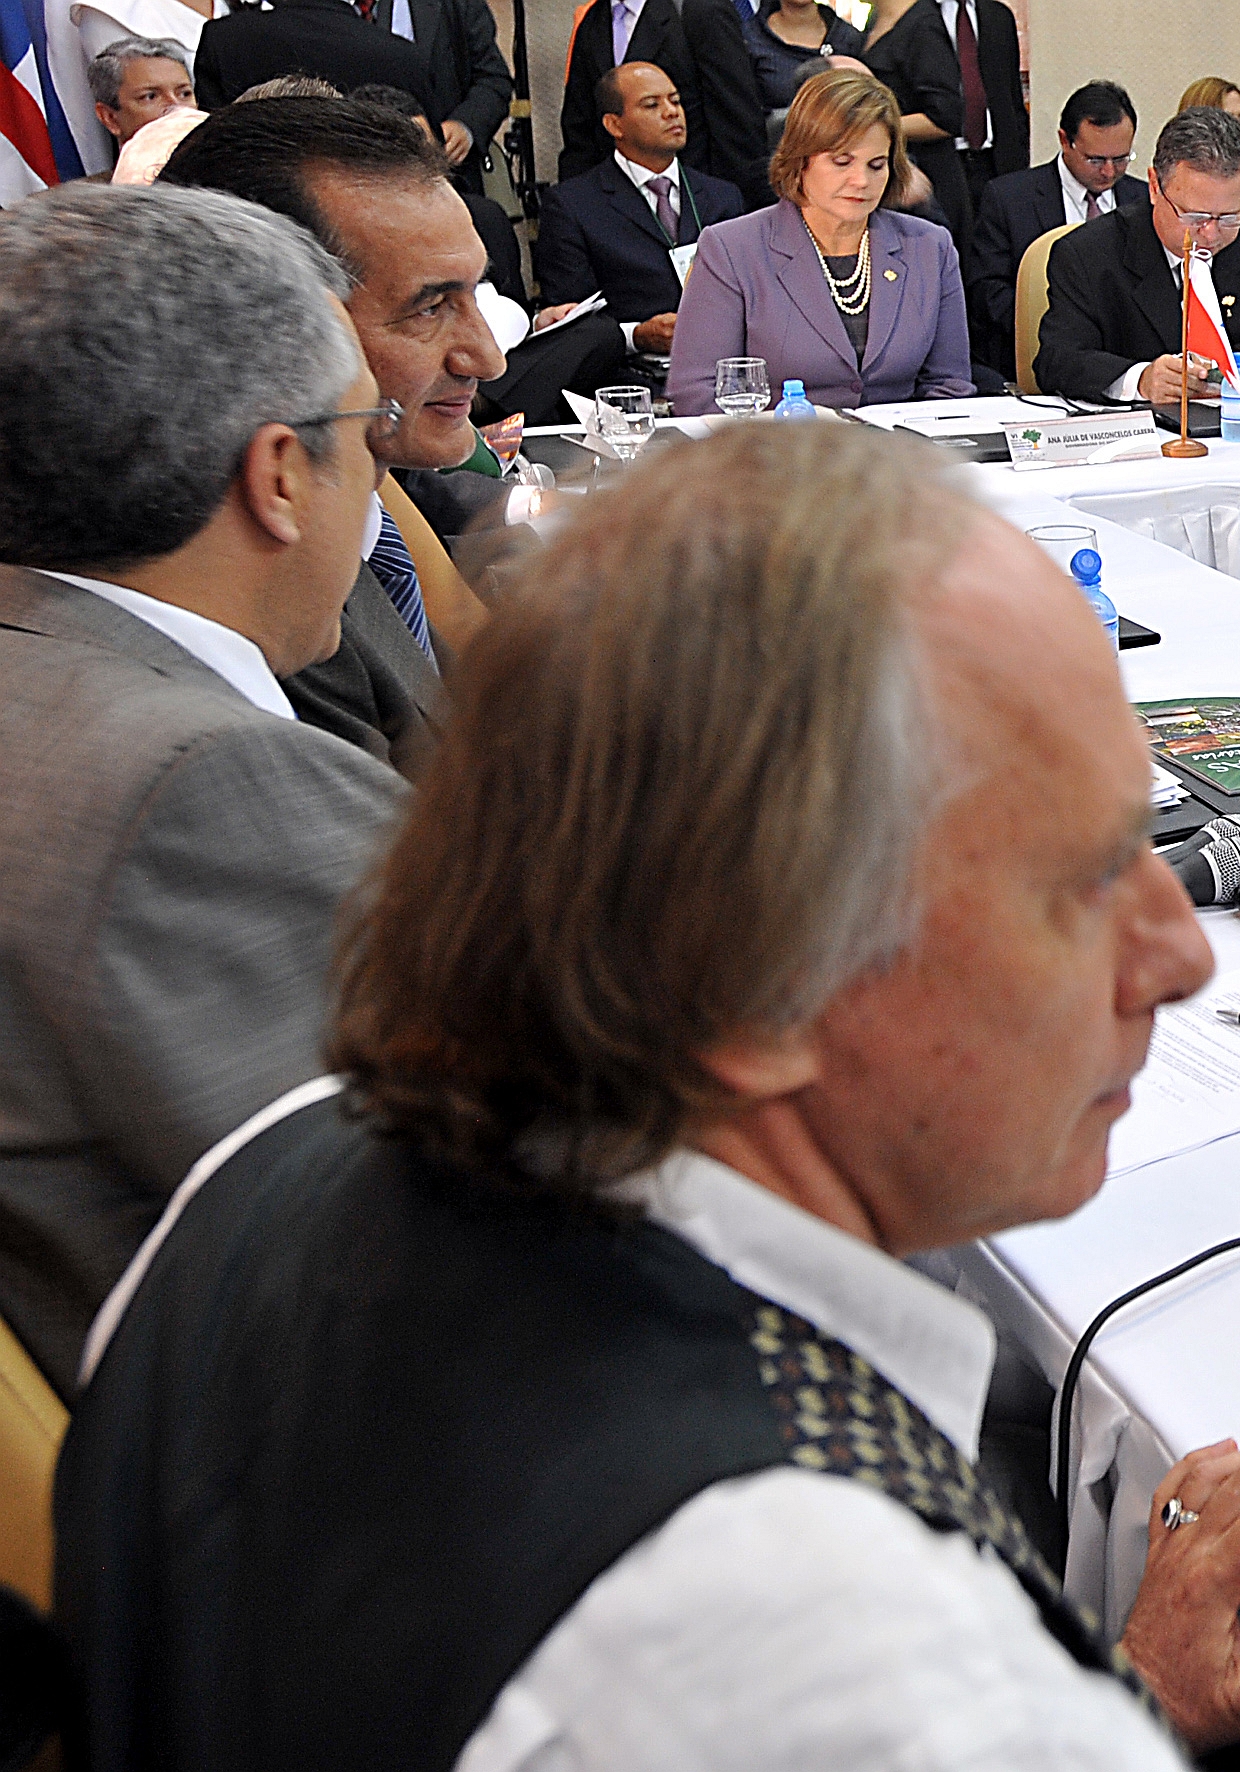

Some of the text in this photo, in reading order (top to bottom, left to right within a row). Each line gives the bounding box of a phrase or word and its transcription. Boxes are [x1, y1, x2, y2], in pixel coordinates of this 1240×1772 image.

[1047, 435, 1062, 444] ANA
[1080, 433, 1089, 441] DE
[1089, 430, 1133, 440] VASCONCELOS
